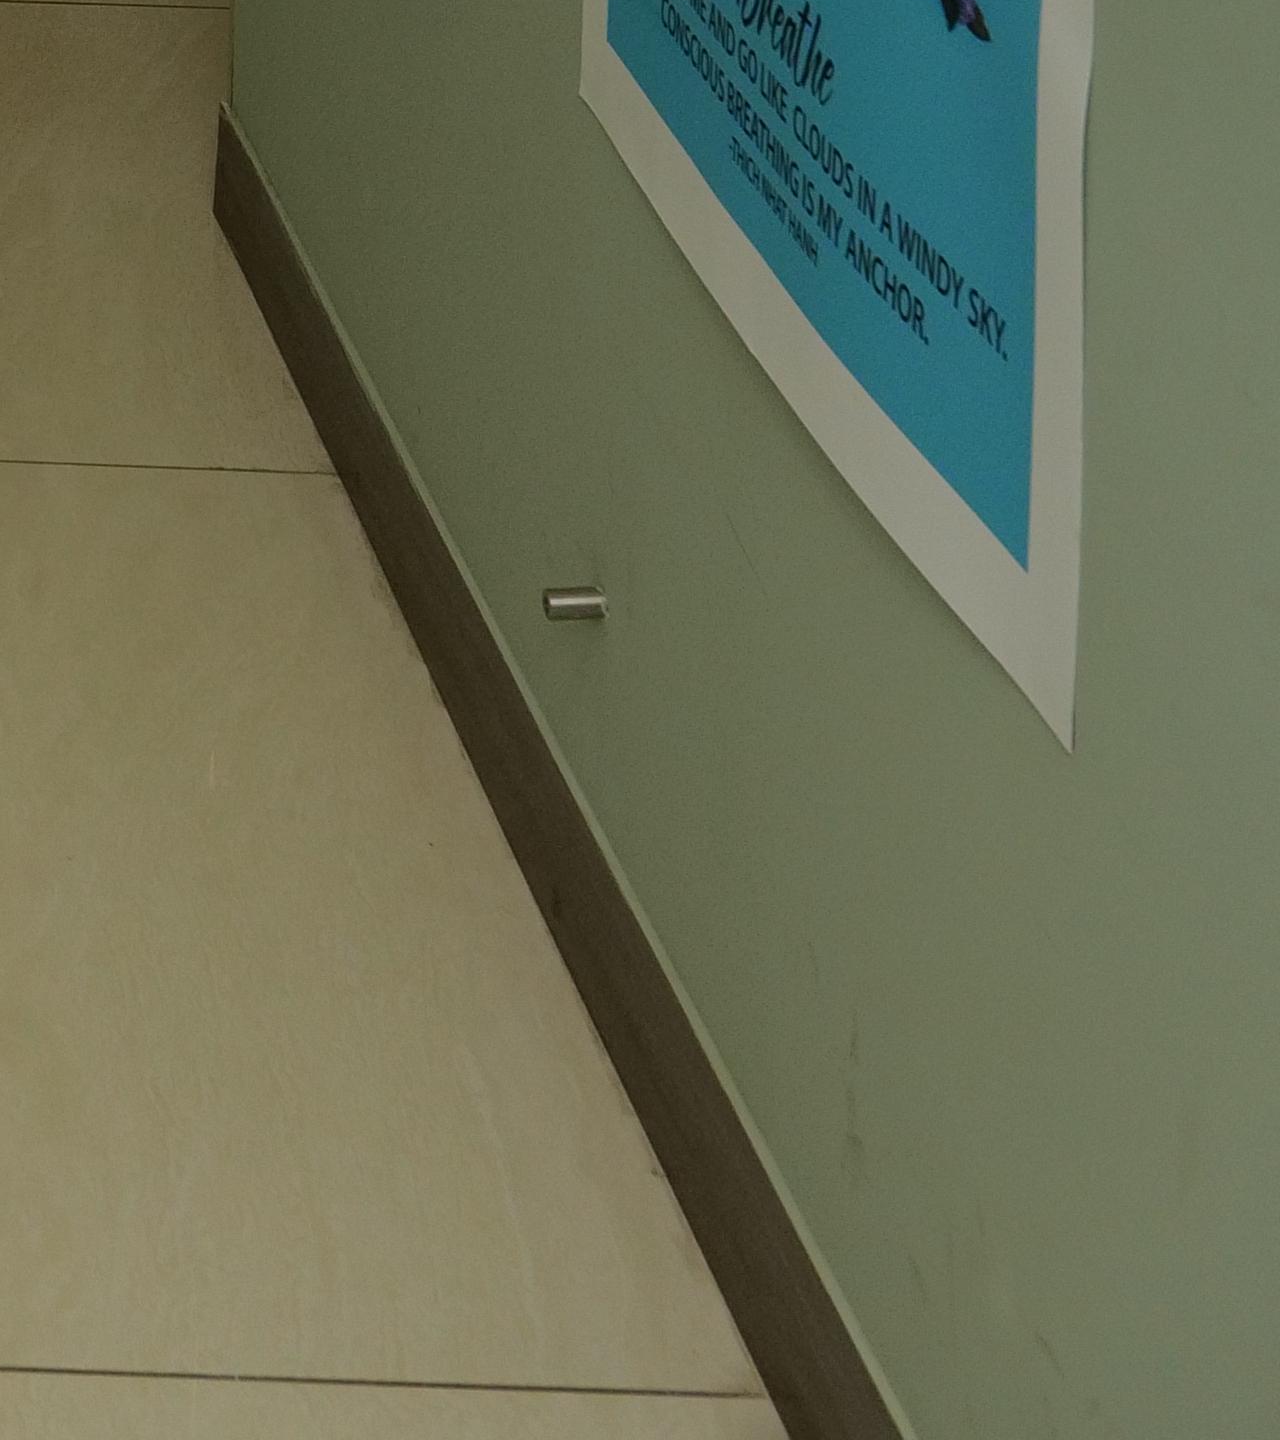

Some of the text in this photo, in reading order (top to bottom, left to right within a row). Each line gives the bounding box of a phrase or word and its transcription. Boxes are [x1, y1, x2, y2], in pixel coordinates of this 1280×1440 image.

[707, 2, 735, 56] AND
[737, 38, 758, 84] GO
[759, 62, 788, 123] LIKE
[792, 104, 853, 198] CLOUDS
[857, 174, 876, 224] IN
[878, 201, 892, 243] A
[897, 213, 964, 309] WINDY
[967, 287, 1008, 361] SKY.
[726, 80, 799, 198] BREATHING
[801, 173, 814, 216] IS
[816, 193, 842, 247] MY
[845, 230, 929, 346] ANCHOR.
[761, 173, 788, 224] NHAT
[788, 209, 818, 267] HANH
